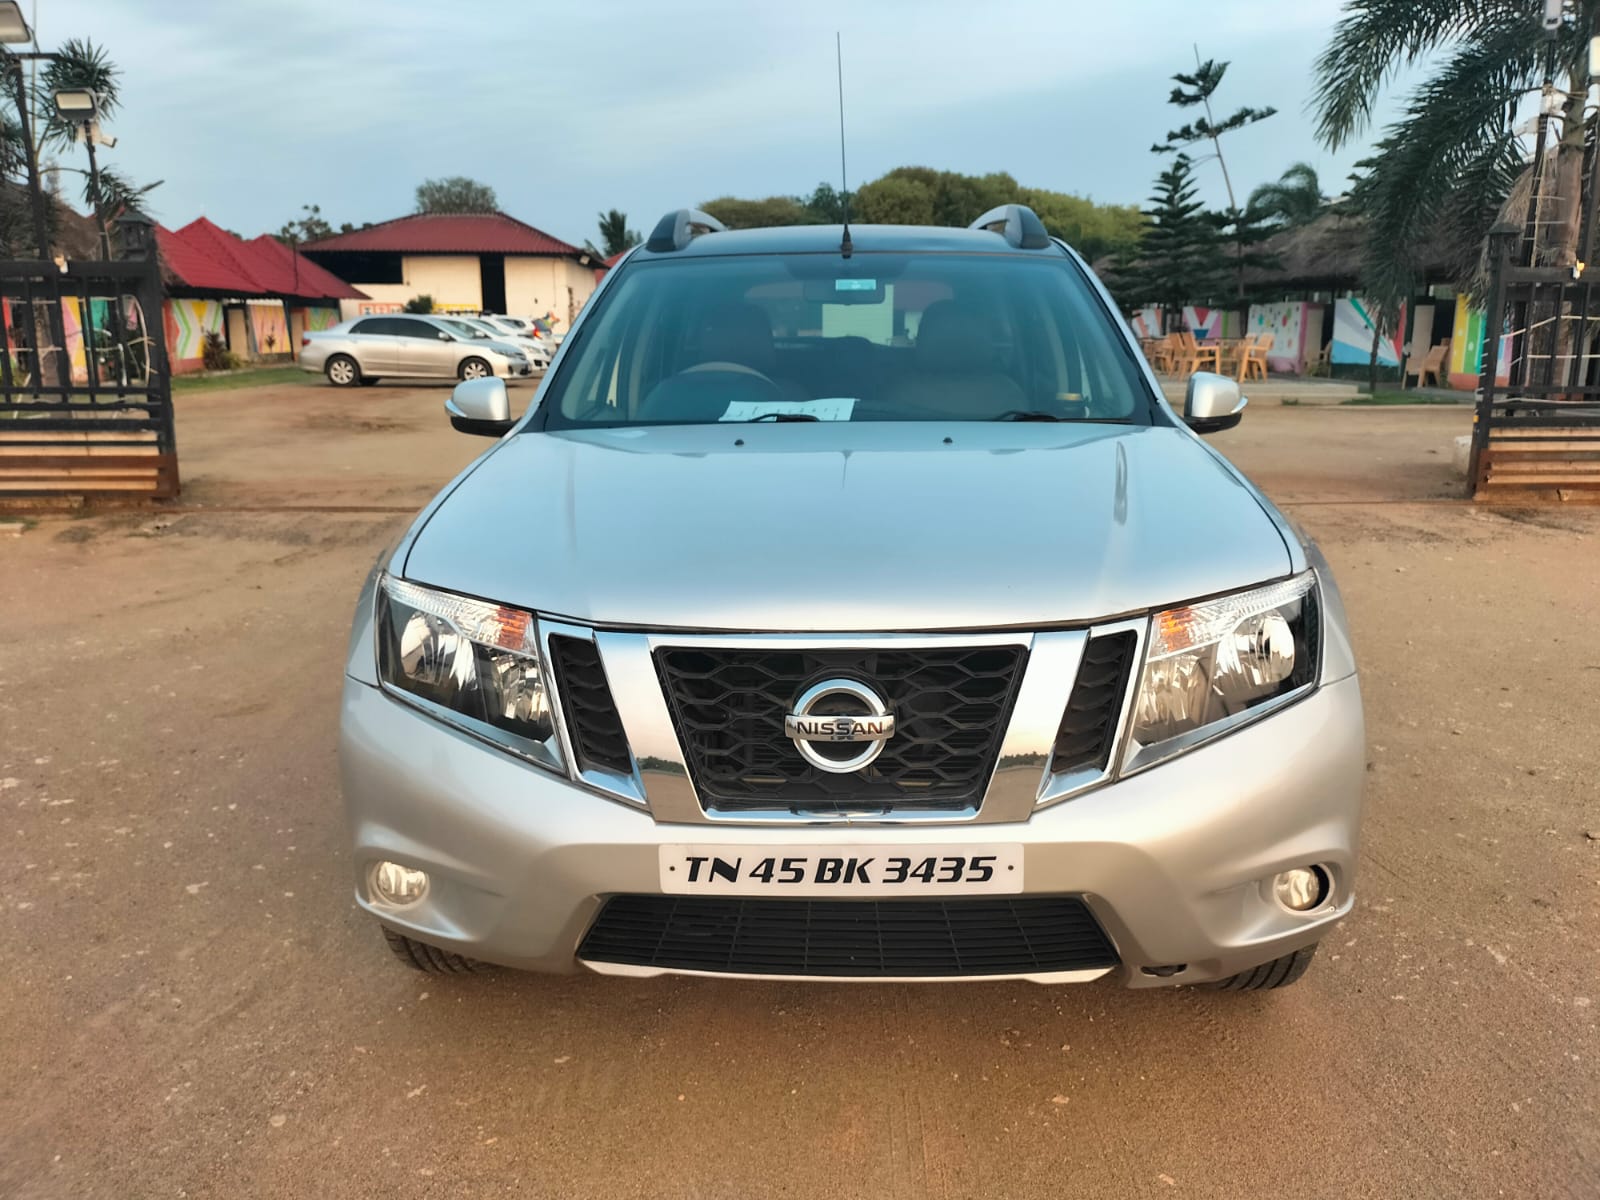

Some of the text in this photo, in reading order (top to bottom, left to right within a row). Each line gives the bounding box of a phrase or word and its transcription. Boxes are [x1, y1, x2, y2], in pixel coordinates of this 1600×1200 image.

[797, 721, 883, 735] NISSAN
[686, 856, 996, 883] TN 45 BK 3435
